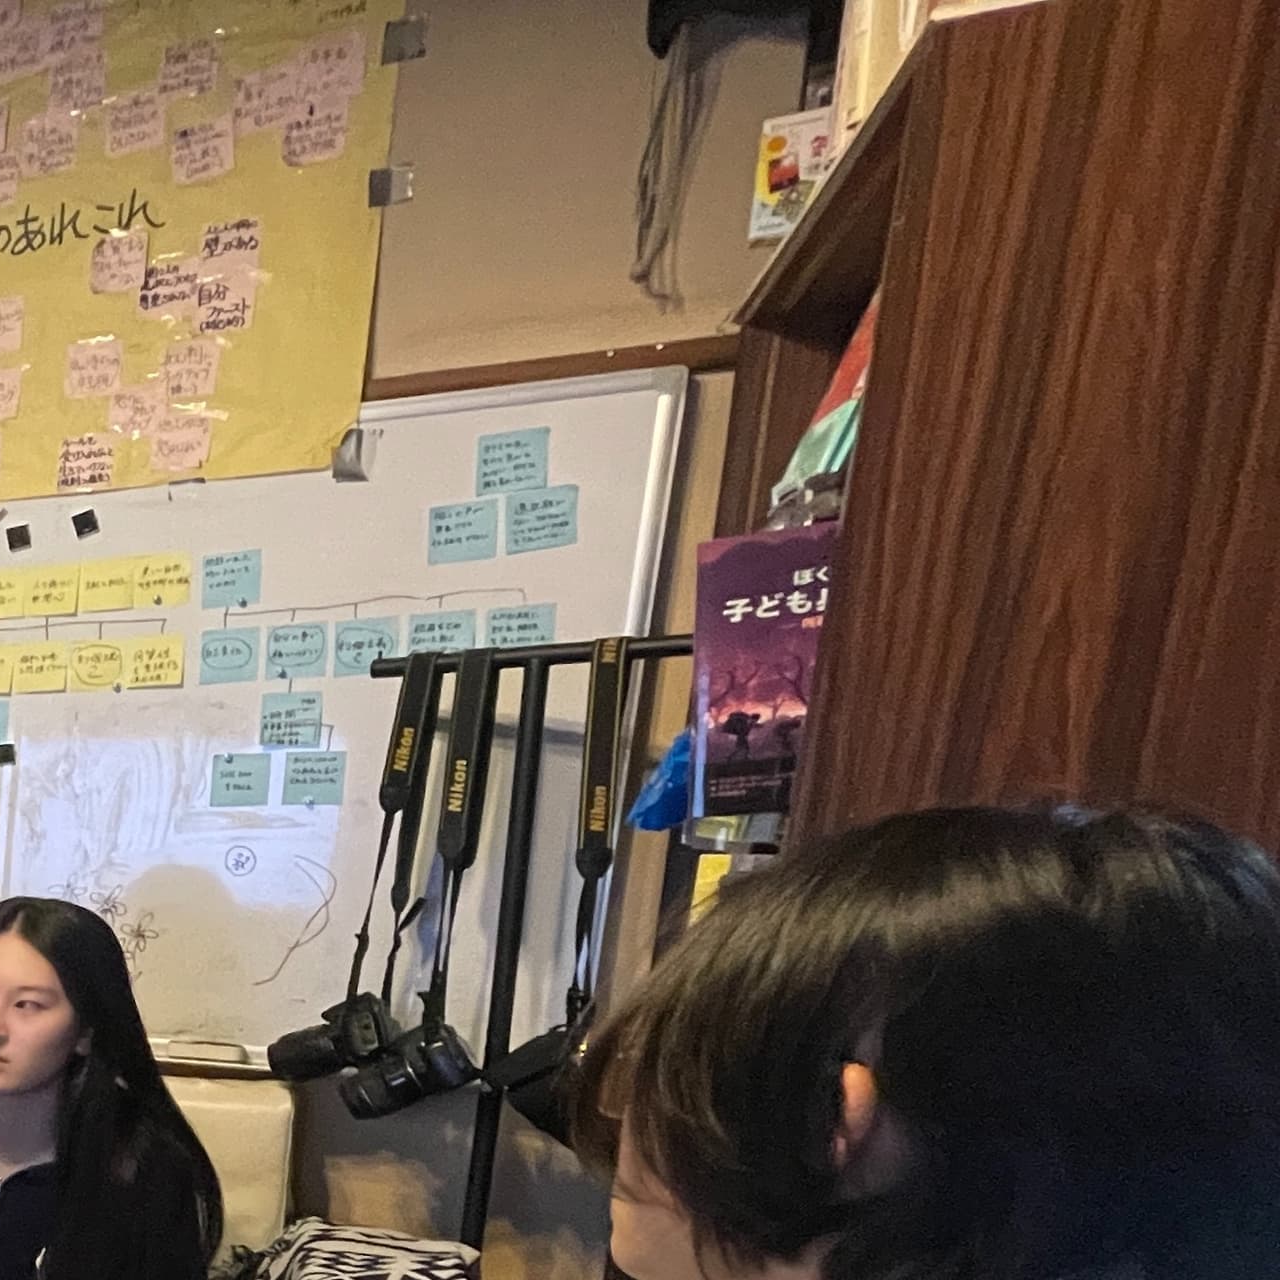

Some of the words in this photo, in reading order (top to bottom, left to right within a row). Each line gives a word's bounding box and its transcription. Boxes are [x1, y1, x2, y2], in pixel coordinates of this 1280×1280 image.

[393, 726, 415, 773] Nikon
[447, 759, 468, 813] Nikon
[589, 785, 608, 832] Nikon
